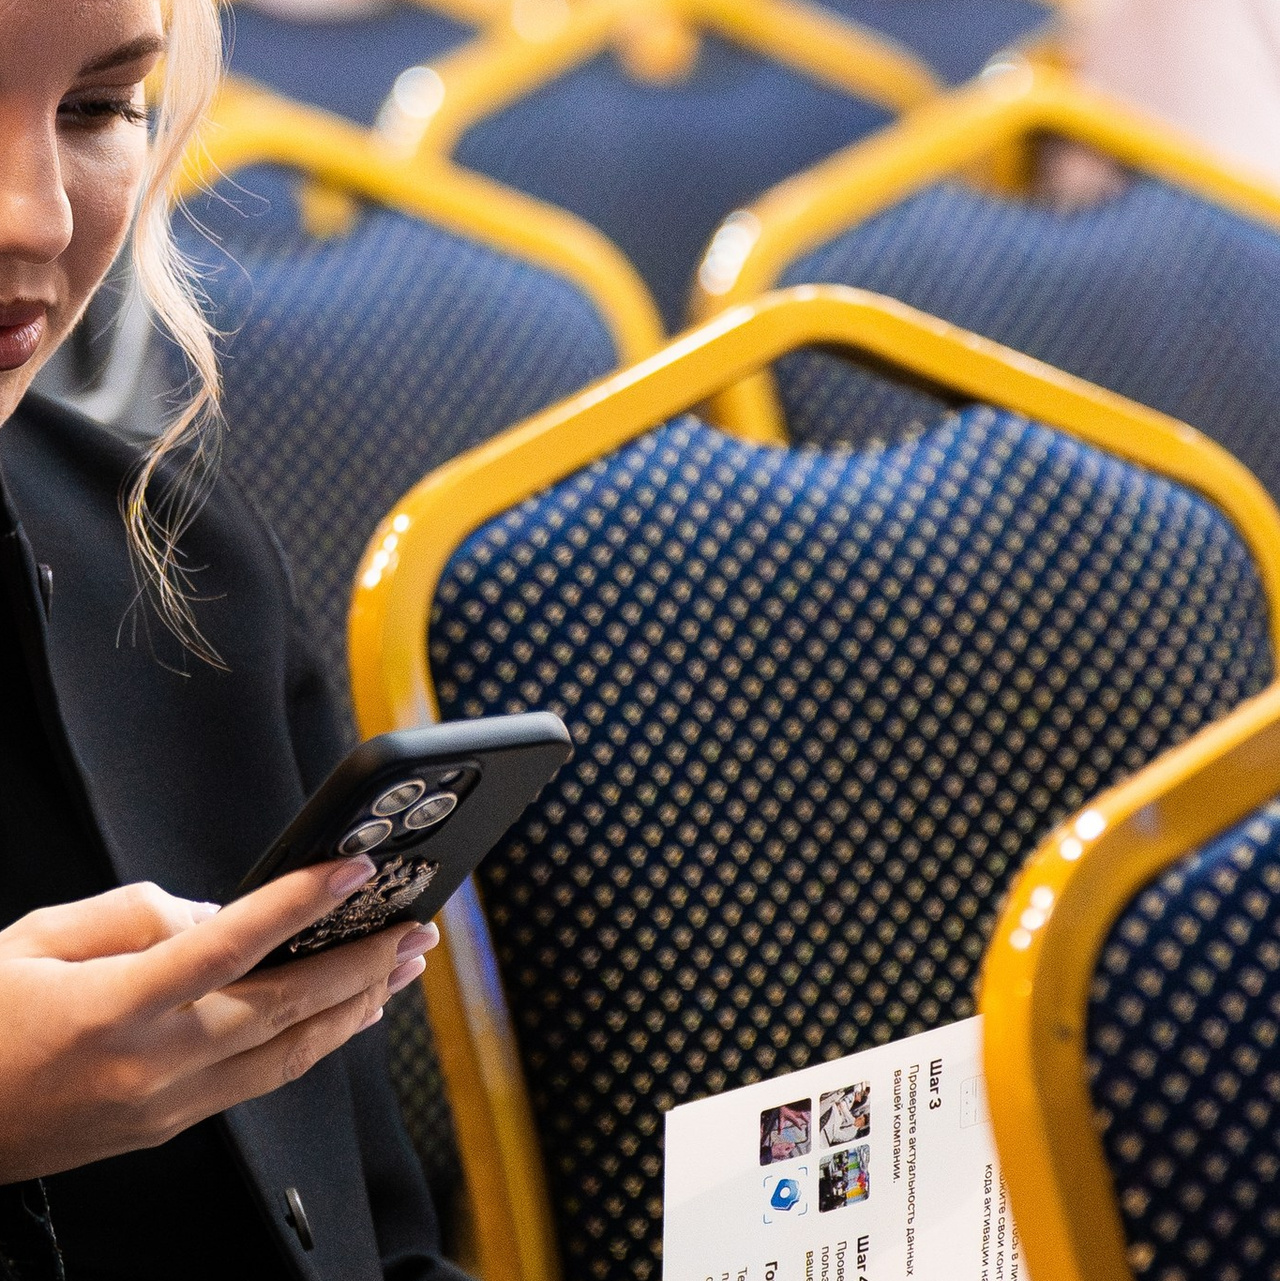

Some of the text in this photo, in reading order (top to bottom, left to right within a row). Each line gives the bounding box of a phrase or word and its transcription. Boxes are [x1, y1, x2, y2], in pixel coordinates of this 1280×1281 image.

[929, 1058, 942, 1110] Шаг 3
[892, 1070, 903, 1184] вашей компании.
[906, 1064, 920, 1277] Проверьте актуальность данных
[984, 1164, 993, 1194] кода
[857, 1235, 869, 1271] Шаг
[981, 1197, 992, 1266] активации
[997, 1217, 1006, 1248] свои
[1012, 1253, 1019, 1261] в
